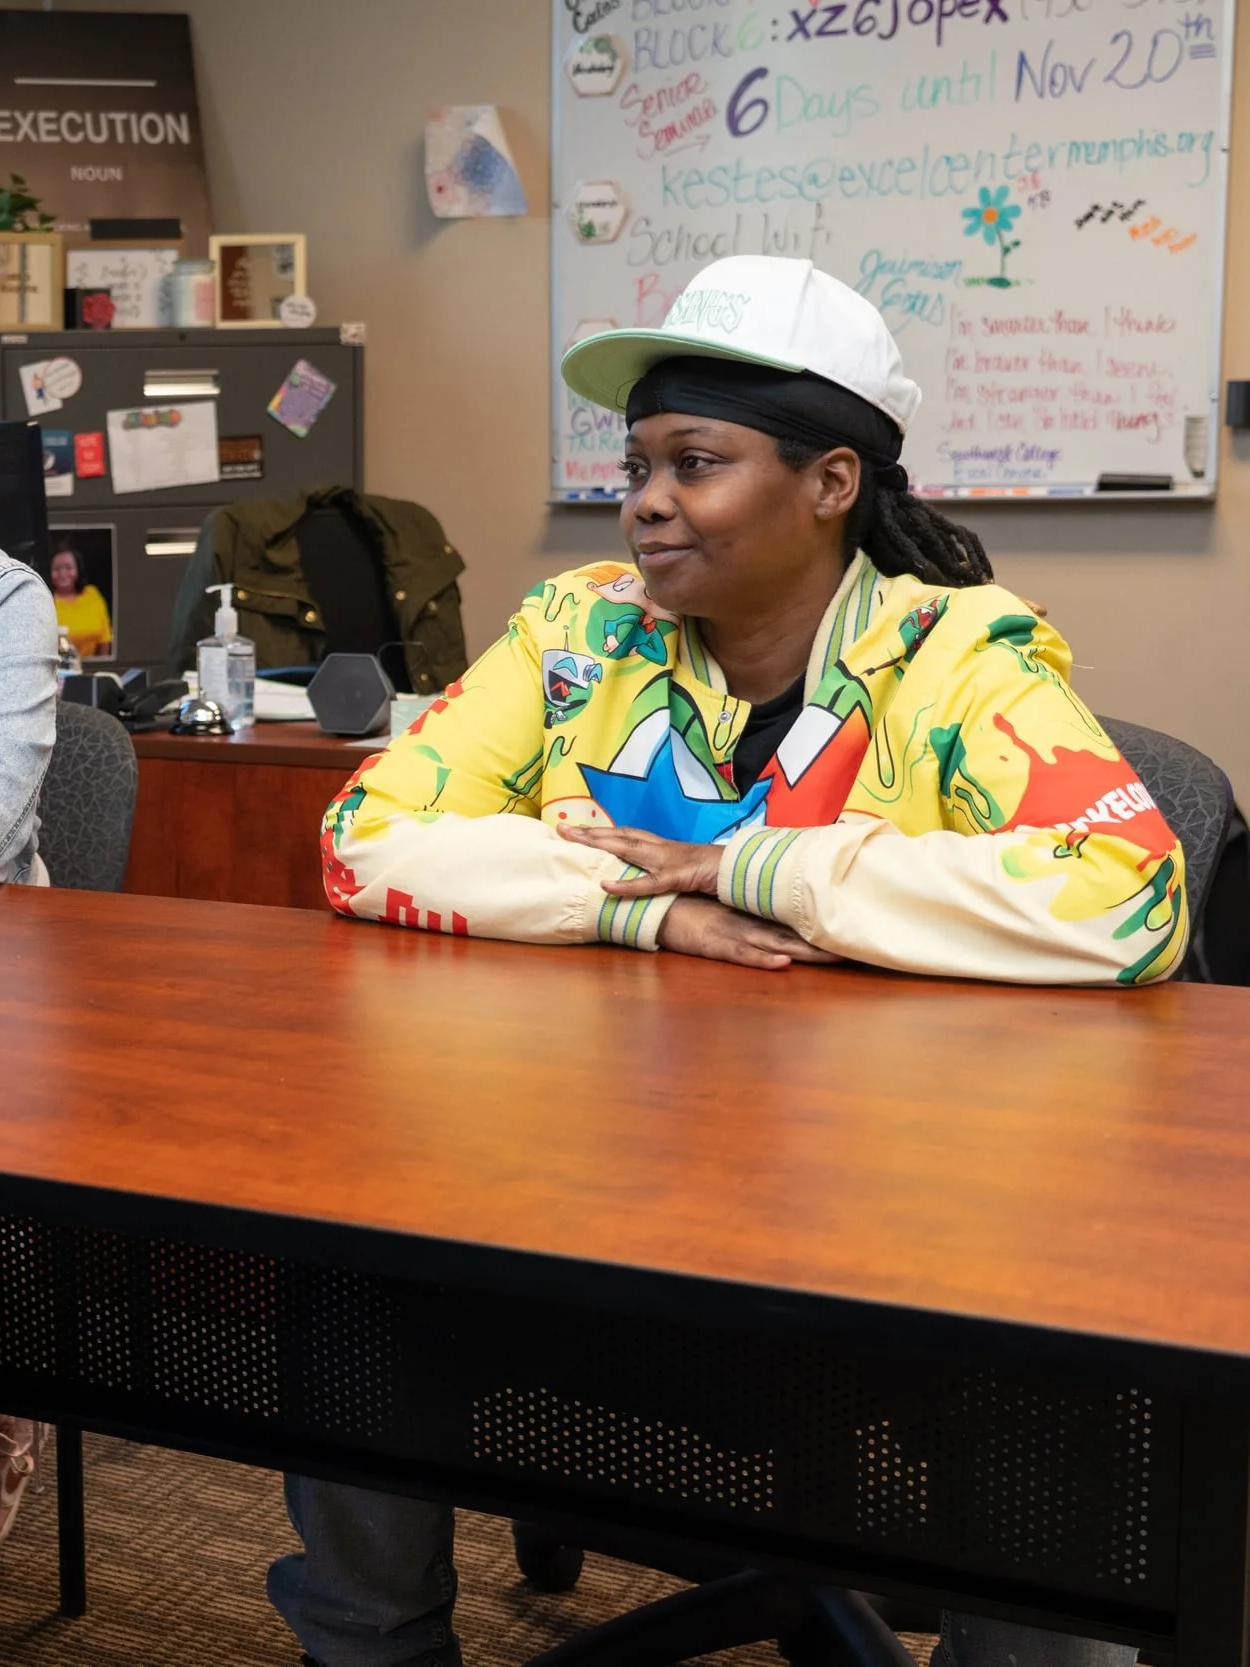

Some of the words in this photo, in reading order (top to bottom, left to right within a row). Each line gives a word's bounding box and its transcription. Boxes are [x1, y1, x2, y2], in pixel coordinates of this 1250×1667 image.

[631, 22, 734, 73] BLOCK
[726, 66, 770, 138] 6
[775, 74, 882, 138] Days
[900, 50, 997, 112] until
[1015, 40, 1097, 102] Nov
[69, 165, 124, 182] NOUN
[626, 214, 742, 266] School
